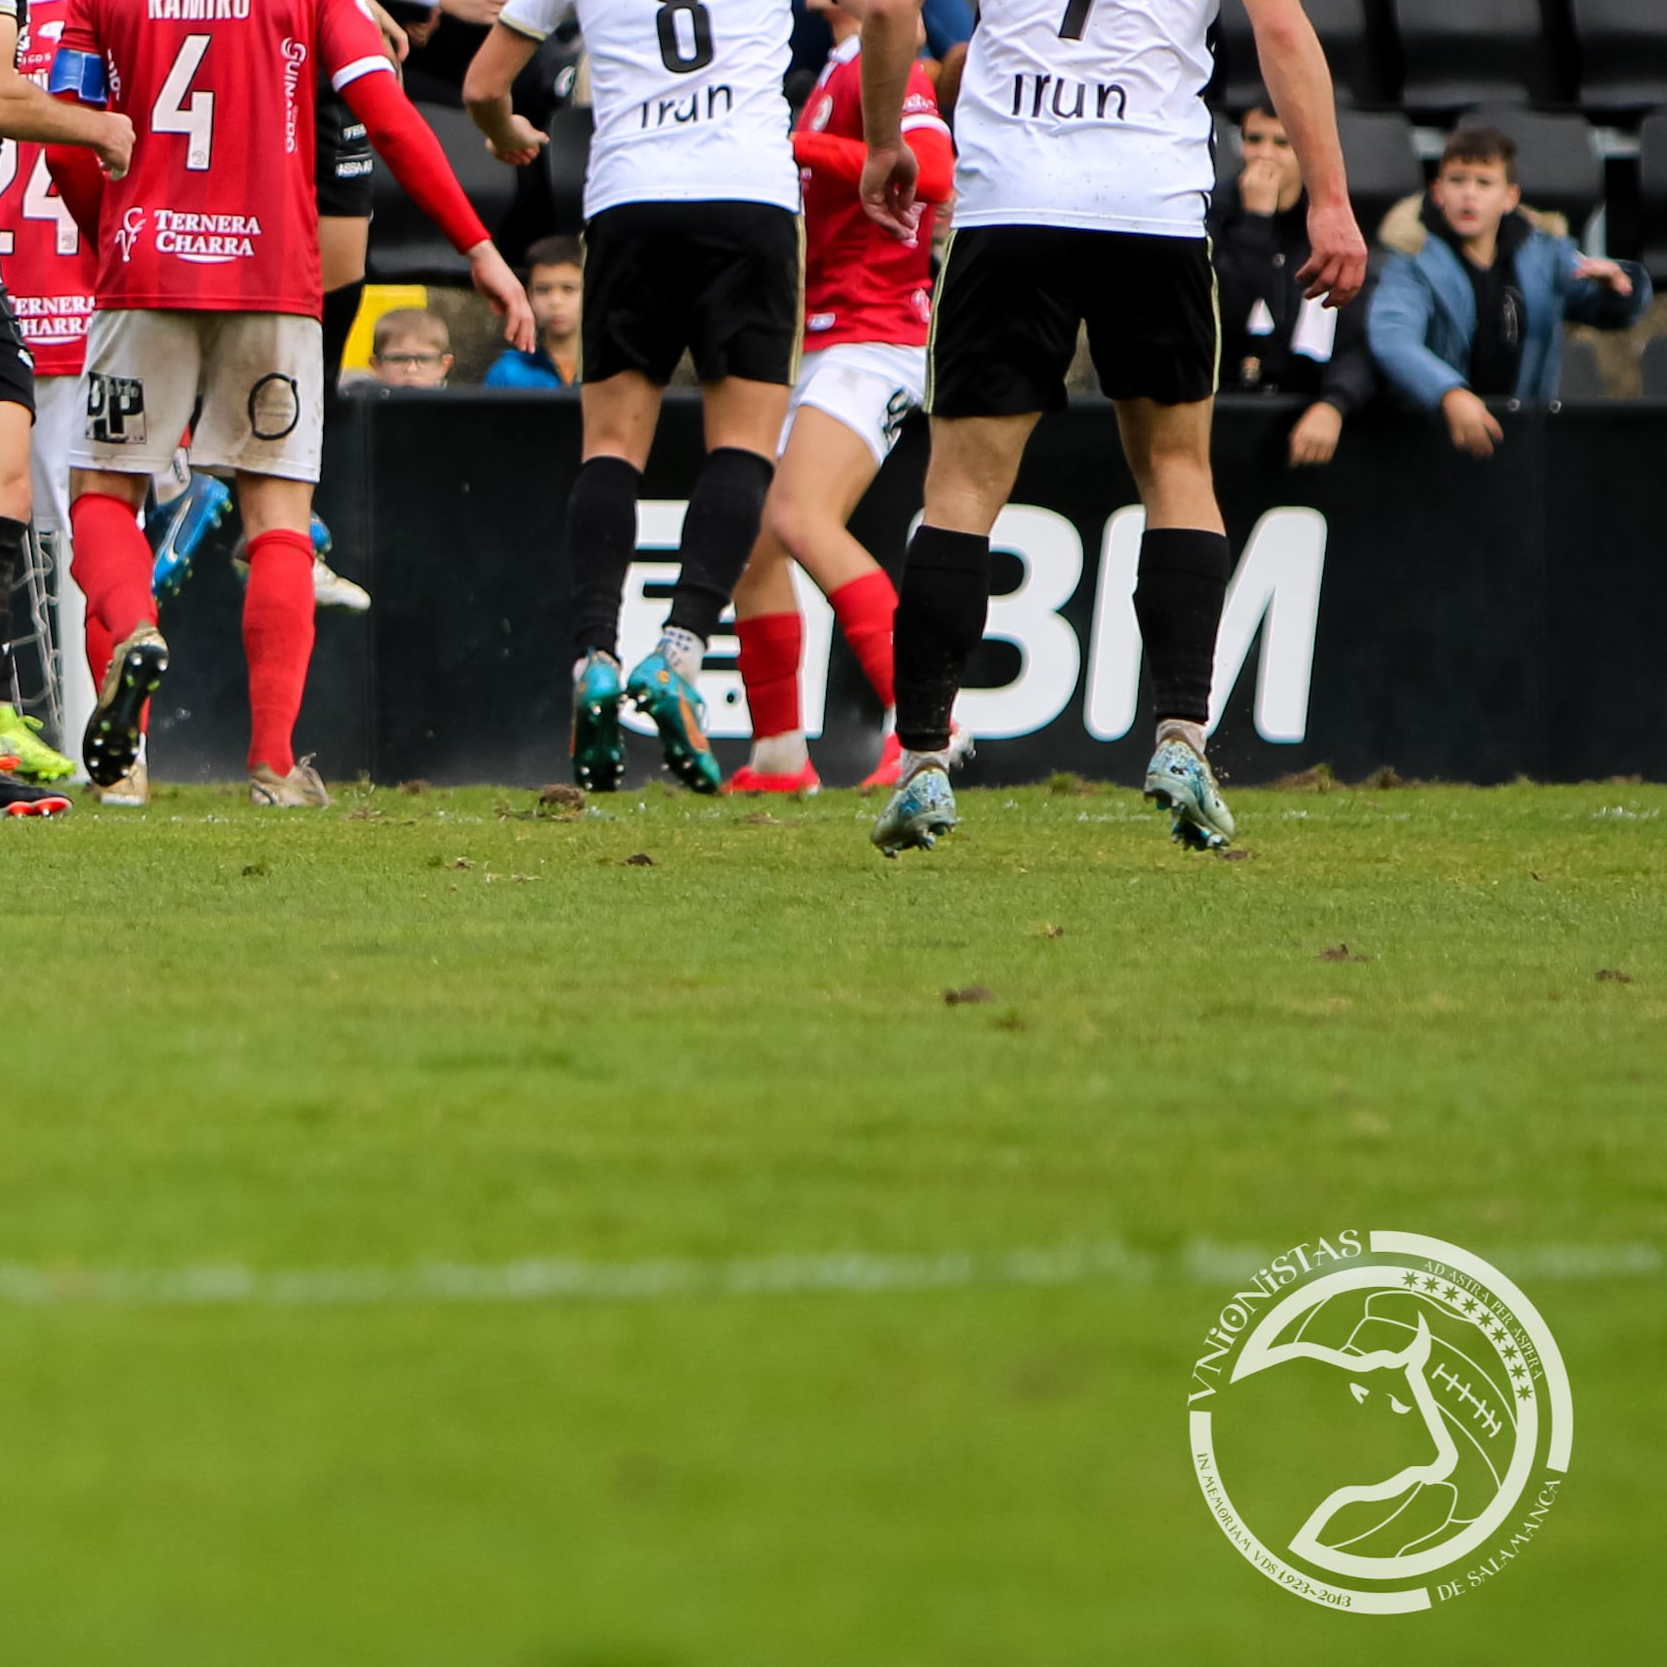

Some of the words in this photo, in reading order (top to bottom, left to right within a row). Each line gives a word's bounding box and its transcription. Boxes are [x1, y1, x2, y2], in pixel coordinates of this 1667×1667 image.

[151, 33, 215, 171] 4
[153, 208, 262, 235] TERNERA
[155, 232, 255, 257] CHARRA
